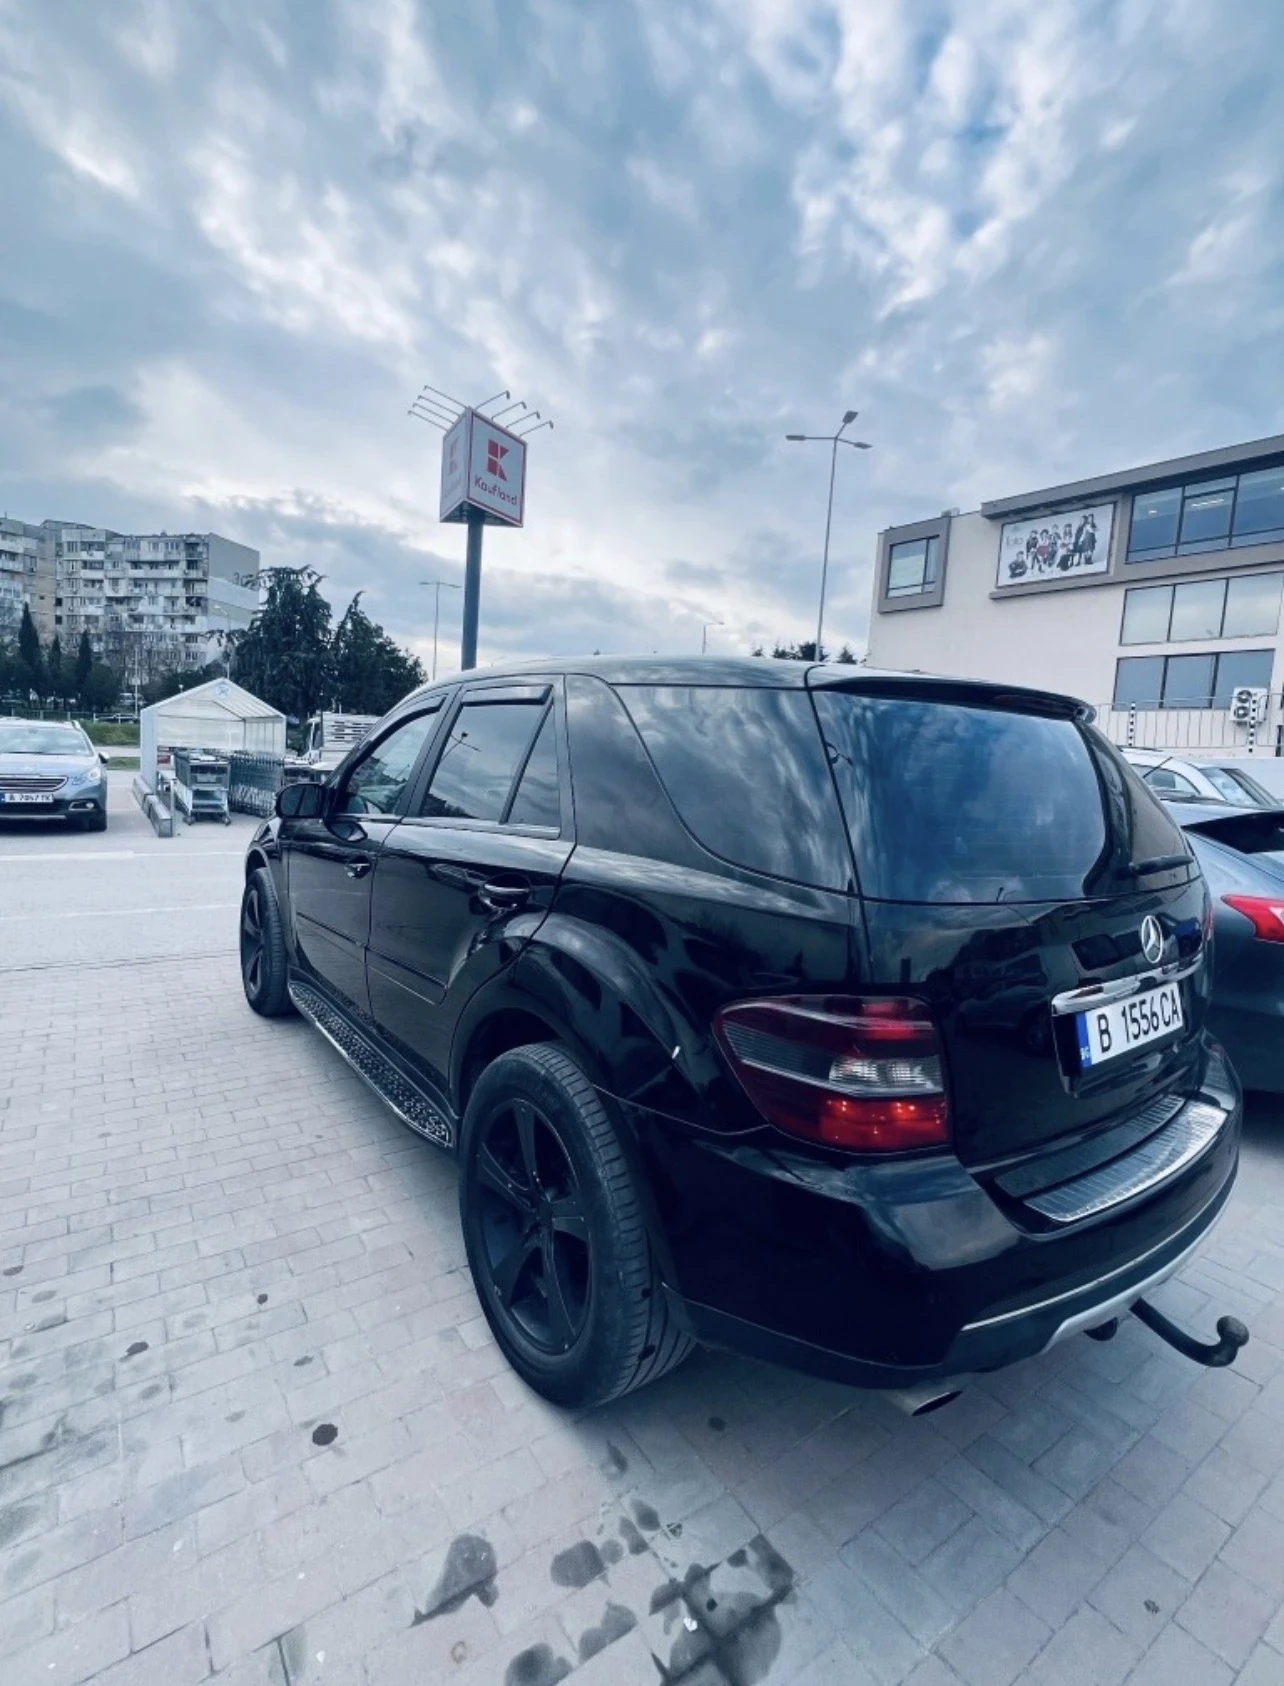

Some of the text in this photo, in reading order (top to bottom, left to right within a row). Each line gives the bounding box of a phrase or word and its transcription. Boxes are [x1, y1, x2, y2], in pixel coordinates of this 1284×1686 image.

[487, 438, 510, 481] K
[474, 475, 518, 505] Kaufland
[1097, 989, 1181, 1053] B 1556 CA
